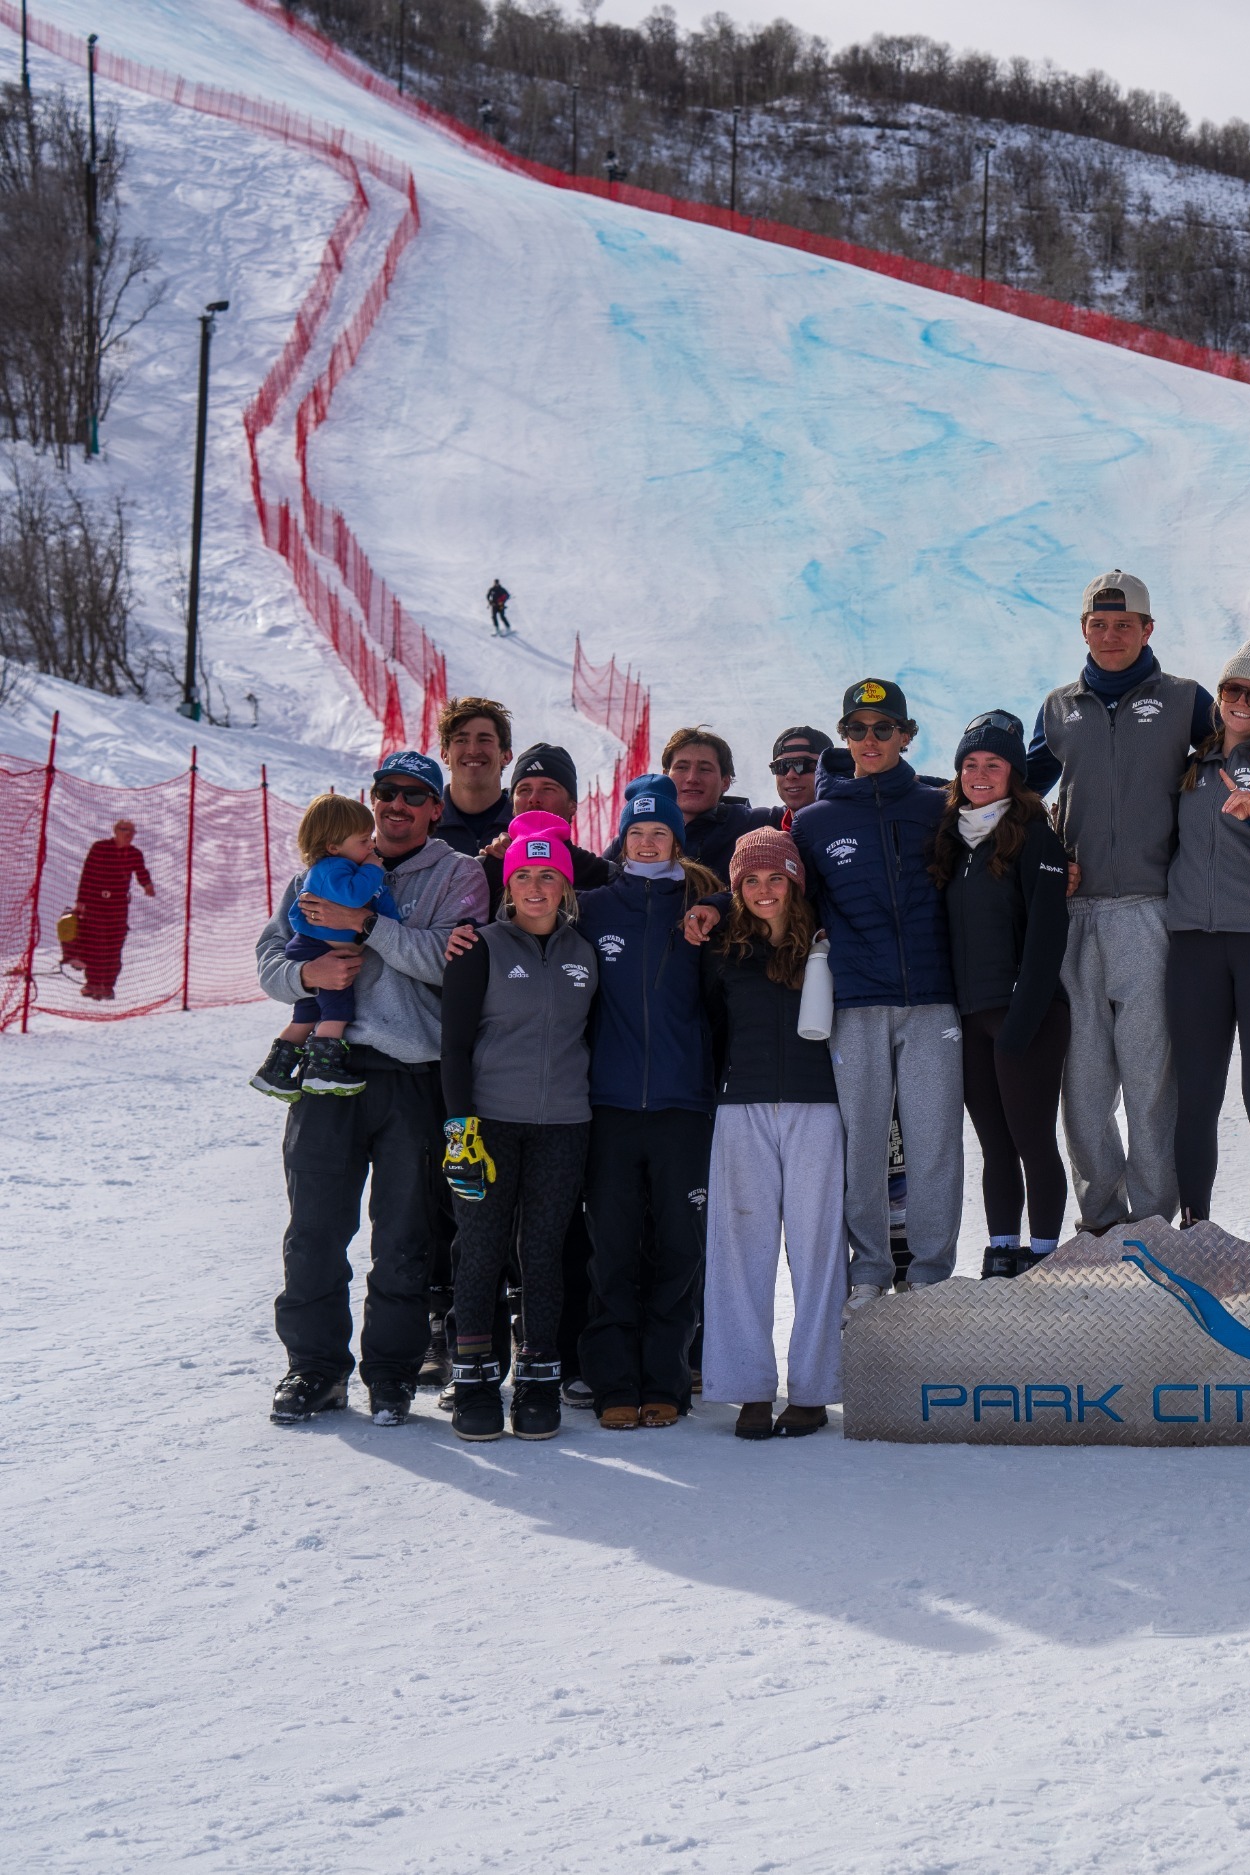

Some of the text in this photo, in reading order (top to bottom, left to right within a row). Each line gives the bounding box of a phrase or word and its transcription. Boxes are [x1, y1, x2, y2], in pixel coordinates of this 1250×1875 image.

[1132, 699, 1163, 709] NEVADA
[826, 838, 859, 854] NEVADA
[598, 934, 626, 946] NEVADA
[921, 1384, 1124, 1422] PARK
